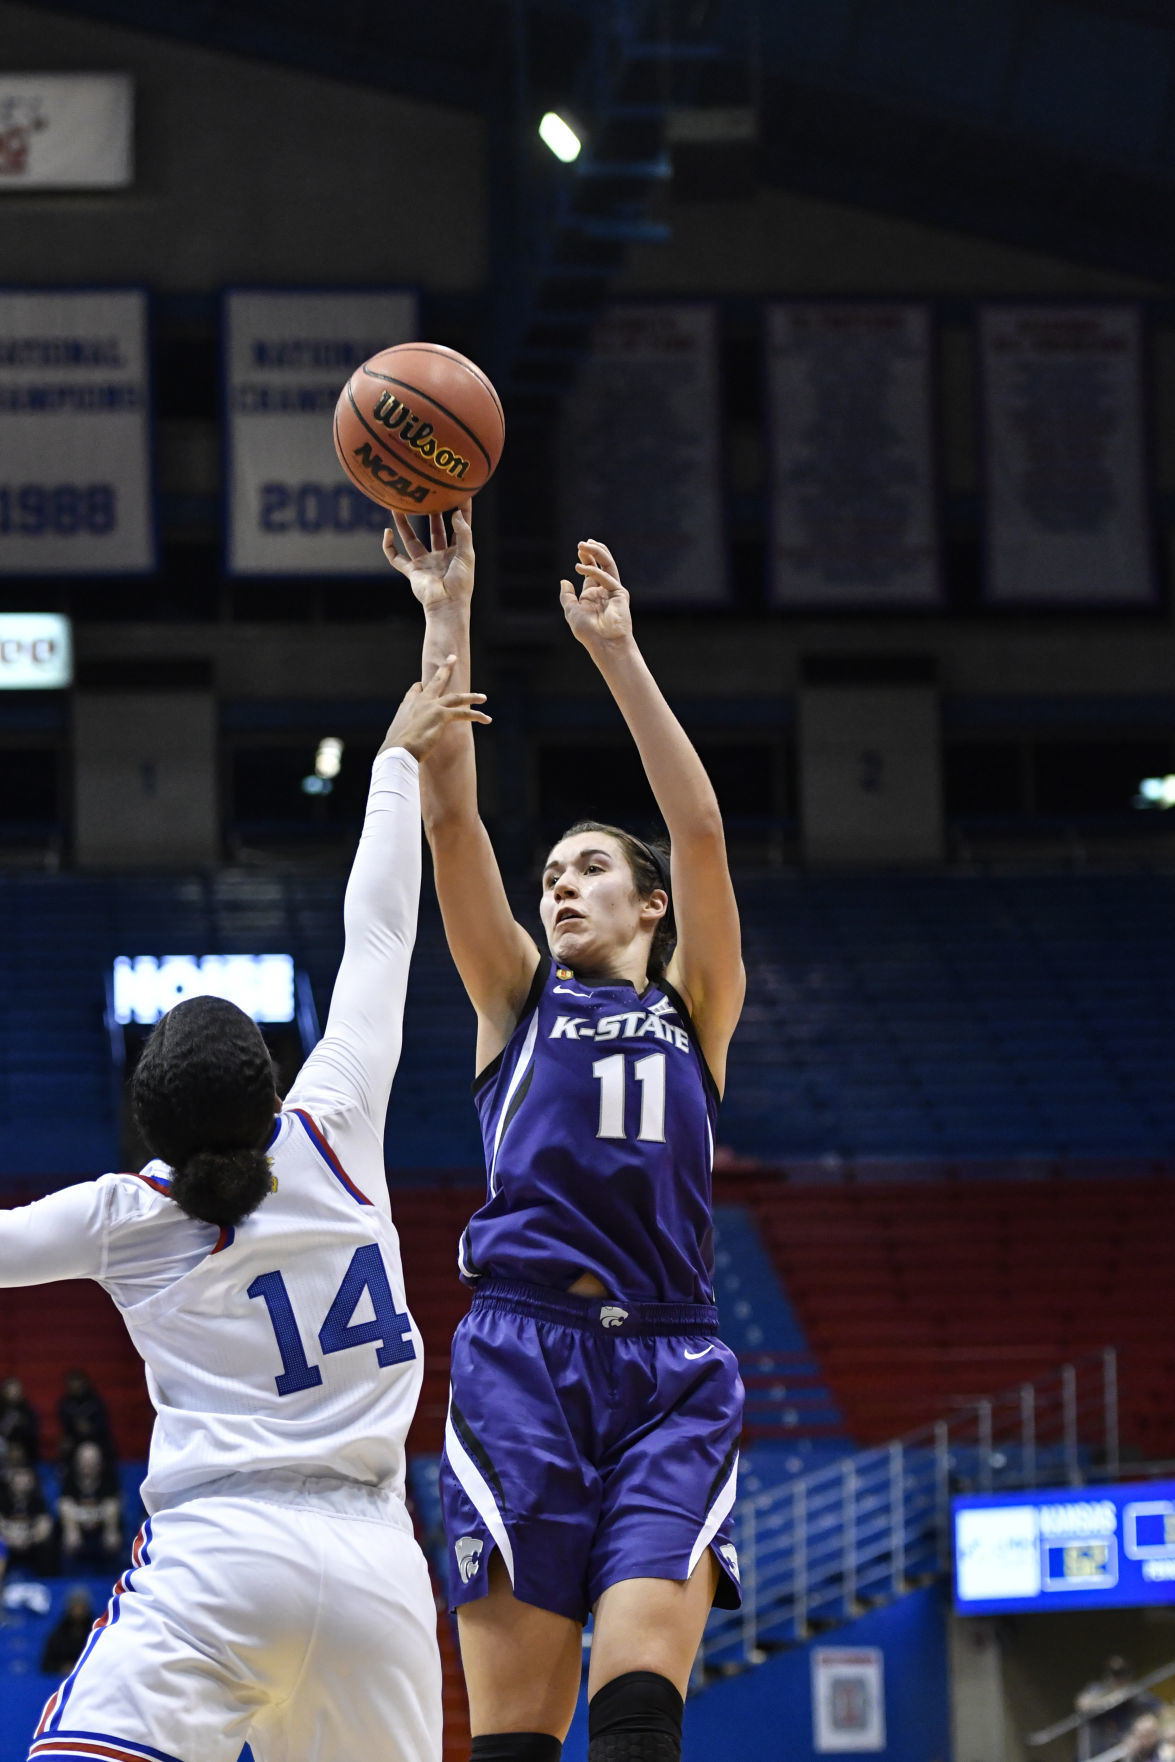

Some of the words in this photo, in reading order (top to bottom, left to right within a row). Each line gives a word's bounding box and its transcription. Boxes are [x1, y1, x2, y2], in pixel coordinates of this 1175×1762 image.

[354, 442, 430, 503] NCAA
[373, 390, 471, 479] Wilson
[549, 1011, 690, 1054] K-STATE
[592, 1053, 667, 1143] 11
[247, 1243, 416, 1397] 14
